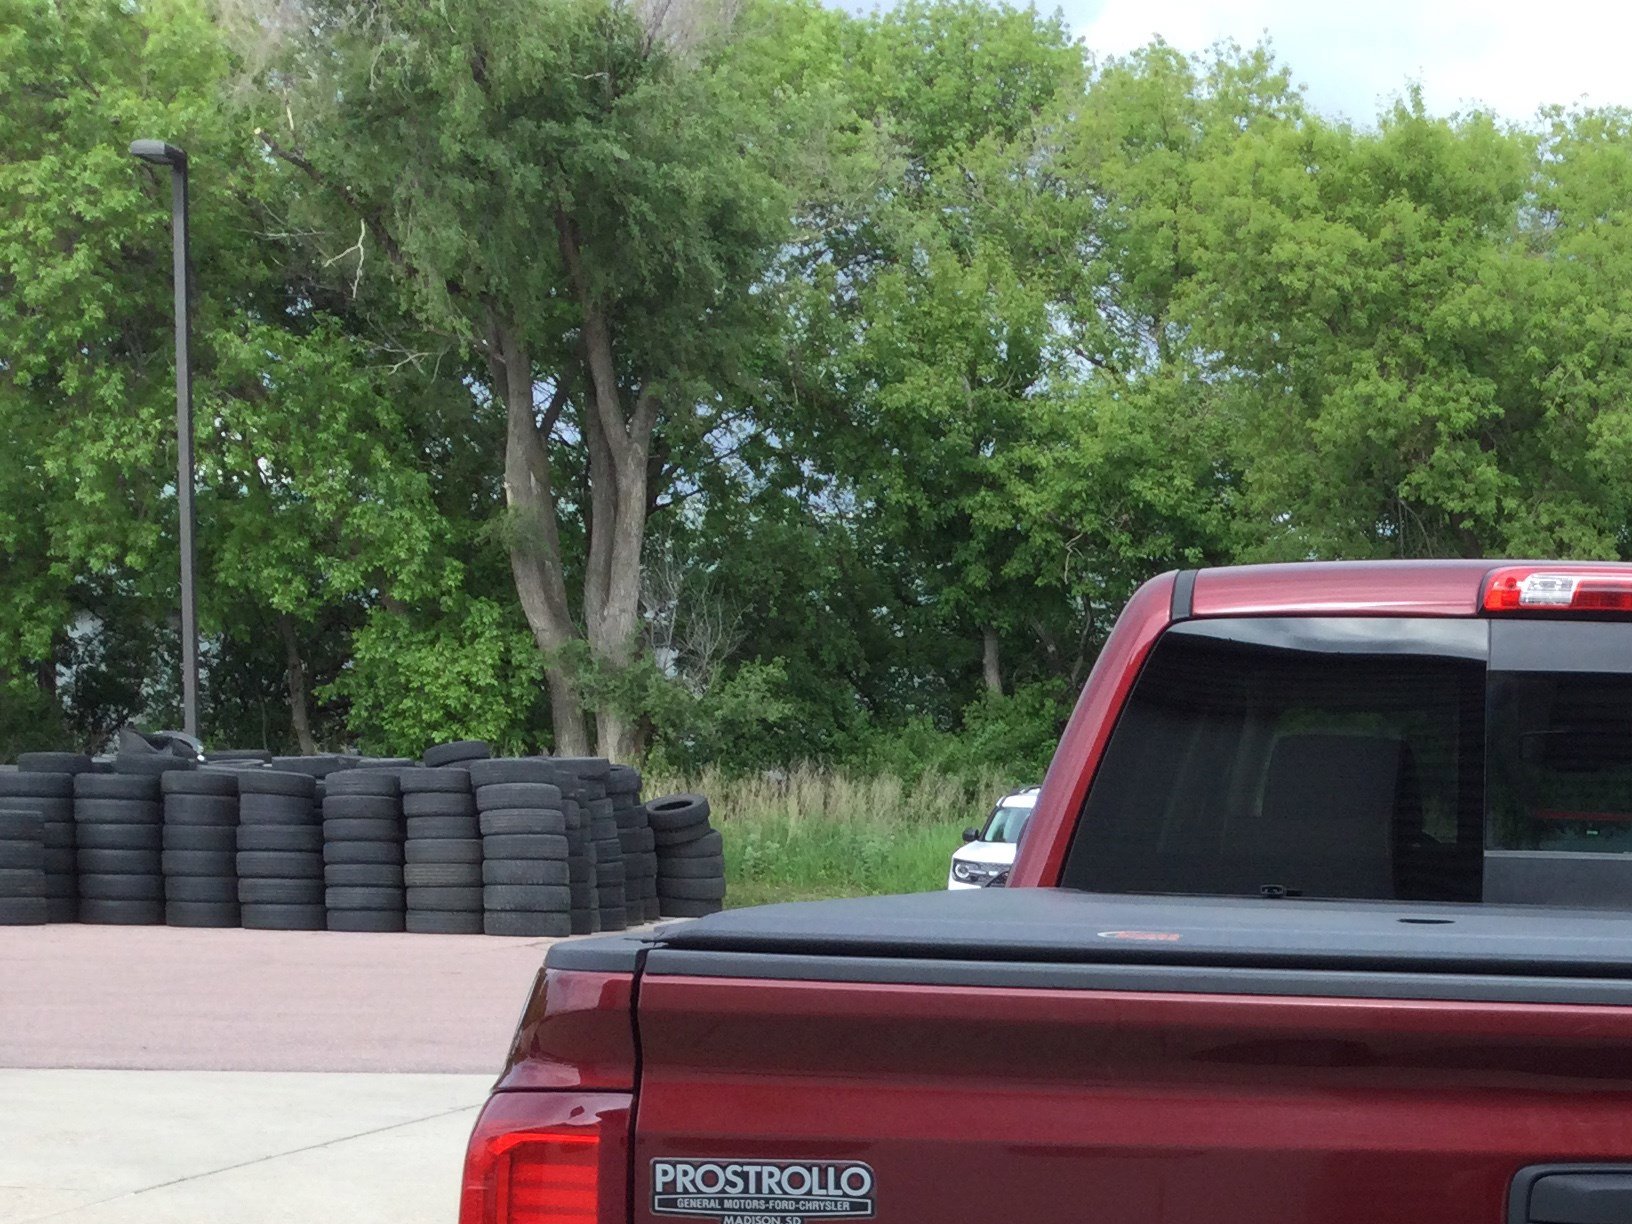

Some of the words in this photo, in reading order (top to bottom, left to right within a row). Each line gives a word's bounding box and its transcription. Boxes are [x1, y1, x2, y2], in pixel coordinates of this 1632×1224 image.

[655, 1163, 872, 1196] PROSTROLLO
[677, 1198, 721, 1209] GENERAL
[724, 1198, 850, 1211] MOTORS-FORD-CHRYSLER
